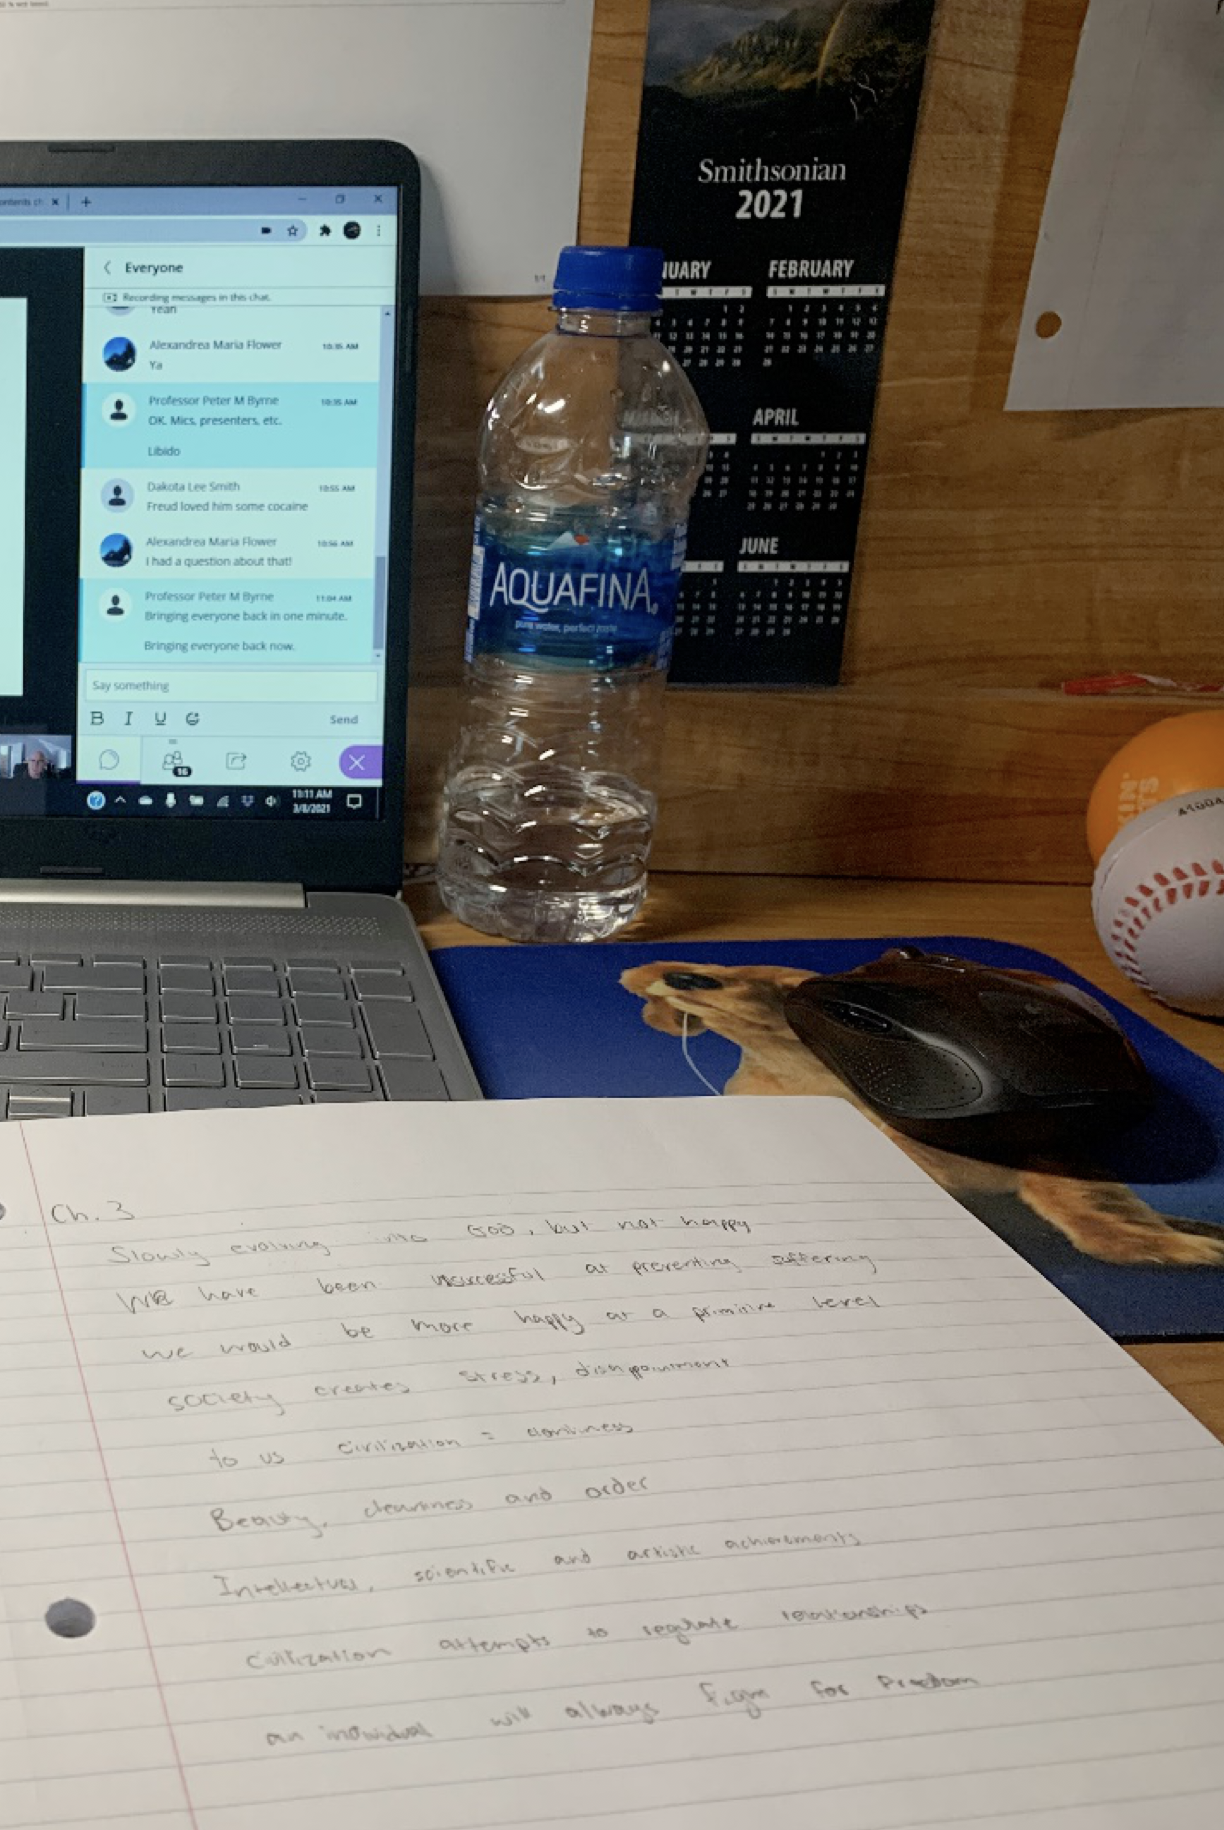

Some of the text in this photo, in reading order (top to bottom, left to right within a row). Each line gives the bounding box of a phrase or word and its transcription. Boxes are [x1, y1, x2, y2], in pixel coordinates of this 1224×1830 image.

[697, 157, 846, 184] Smithsonian
[735, 189, 803, 219] 2021
[126, 262, 183, 276] Everyone
[768, 259, 855, 279] FEBRUARY
[150, 361, 162, 370] Ya
[149, 396, 279, 408] Professor Peter M Byrne
[148, 416, 282, 427] OK. Mics, presenters, etc.
[752, 408, 800, 426] APRIL
[148, 446, 181, 456] Libido
[147, 482, 240, 492] Dakota Lee Smith
[147, 502, 178, 511] Freud
[181, 502, 209, 511] loved
[212, 502, 233, 511] him
[267, 502, 308, 511] cocaine
[738, 537, 779, 555] JUNE
[146, 557, 149, 566] I
[152, 557, 172, 566] had
[184, 557, 231, 567] question
[233, 557, 264, 566] about
[267, 557, 292, 566] that!
[490, 562, 652, 613] AQUAFINA
[145, 591, 274, 603] Professor Peter M Byrne
[145, 612, 188, 622] Bringing
[191, 613, 240, 622] everyone
[243, 611, 267, 621] back
[283, 613, 303, 621] one
[306, 612, 347, 621] minute.
[145, 641, 188, 653] Bringing
[191, 643, 240, 653] everyone
[243, 641, 267, 650] back
[93, 680, 169, 693] Say something
[329, 714, 359, 725] Send
[292, 789, 333, 799] 11:11 AM
[51, 1201, 135, 1224] Ch. 3
[680, 1214, 750, 1233] happy
[197, 1277, 377, 1302] have been
[220, 1309, 587, 1354] would more happy
[167, 1391, 286, 1417] society
[209, 1476, 652, 1540] Beauty, order
